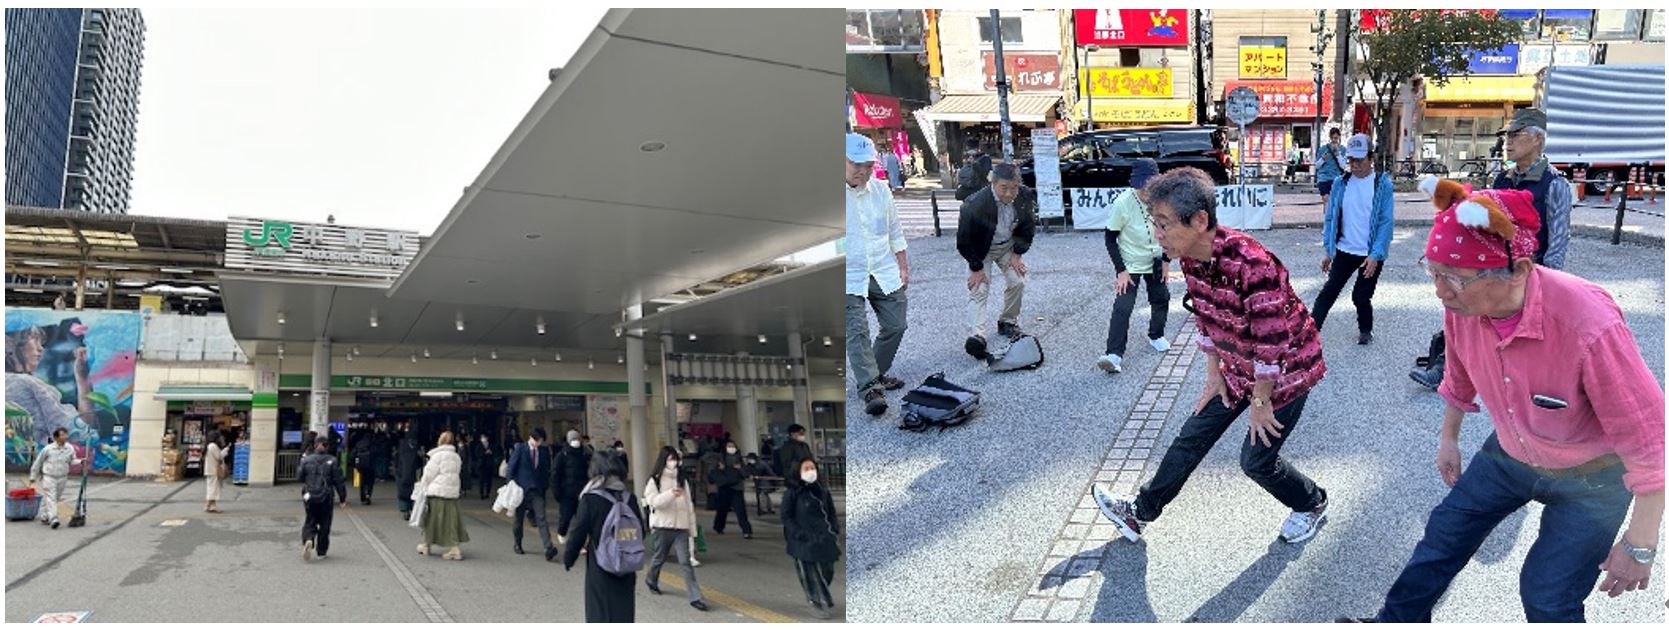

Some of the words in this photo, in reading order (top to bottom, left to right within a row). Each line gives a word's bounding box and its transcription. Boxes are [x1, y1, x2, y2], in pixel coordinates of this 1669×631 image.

[1245, 53, 1283, 62] アパート
[1245, 65, 1283, 75] マンション
[243, 220, 293, 247] JR
